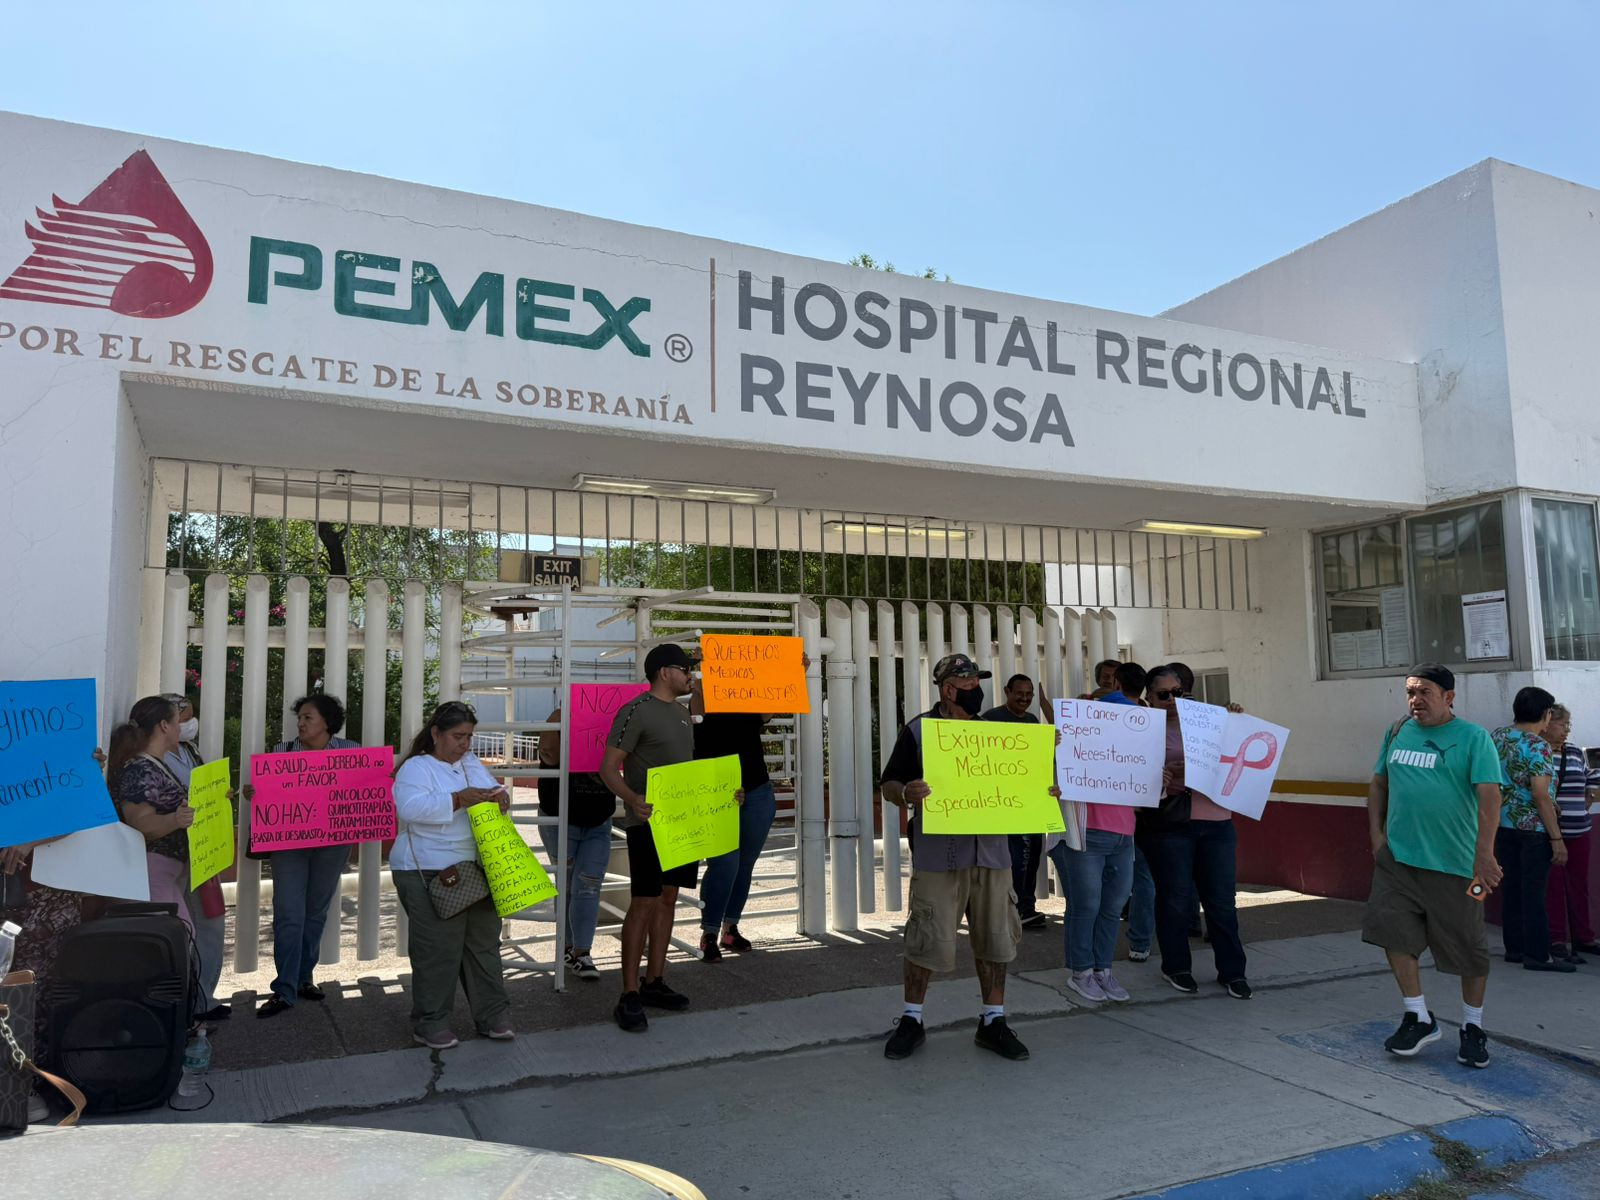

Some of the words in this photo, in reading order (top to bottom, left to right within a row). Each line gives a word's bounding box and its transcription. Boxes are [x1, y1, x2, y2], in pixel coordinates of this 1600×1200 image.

[248, 235, 652, 358] PEMEX
[738, 269, 1077, 377] HOSPITAL
[1096, 327, 1367, 420] REGIONAL
[0, 321, 84, 356] POR
[98, 333, 153, 364] EL
[168, 340, 359, 386] RESCATE
[373, 364, 422, 392] DE
[435, 371, 482, 401] LA
[495, 380, 694, 426] SOBERANÍA
[740, 352, 1077, 449] REYNOSA
[543, 559, 572, 573] EXIT
[535, 573, 580, 588] SALIDA
[705, 637, 780, 661] QUEREMOS
[713, 684, 798, 701] ESPECIALISTAS
[1061, 701, 1079, 719] El
[935, 721, 1029, 758] Exigimos
[1062, 723, 1101, 739] espera
[1073, 743, 1147, 765] Necesitamos
[1390, 749, 1437, 769] PUMA
[255, 760, 271, 776] LA
[275, 758, 307, 775] SALUD
[298, 772, 337, 788] FAVOR
[1062, 767, 1148, 794] Tratamientos
[328, 787, 386, 802] ONCOLOGO
[924, 786, 1024, 817] Especialistas
[255, 804, 279, 827] NO
[282, 801, 317, 824] HAY:
[327, 815, 393, 830] TRATAMIENTOS
[275, 830, 283, 842] DE
[327, 827, 392, 842] MEDICAMENTOS
